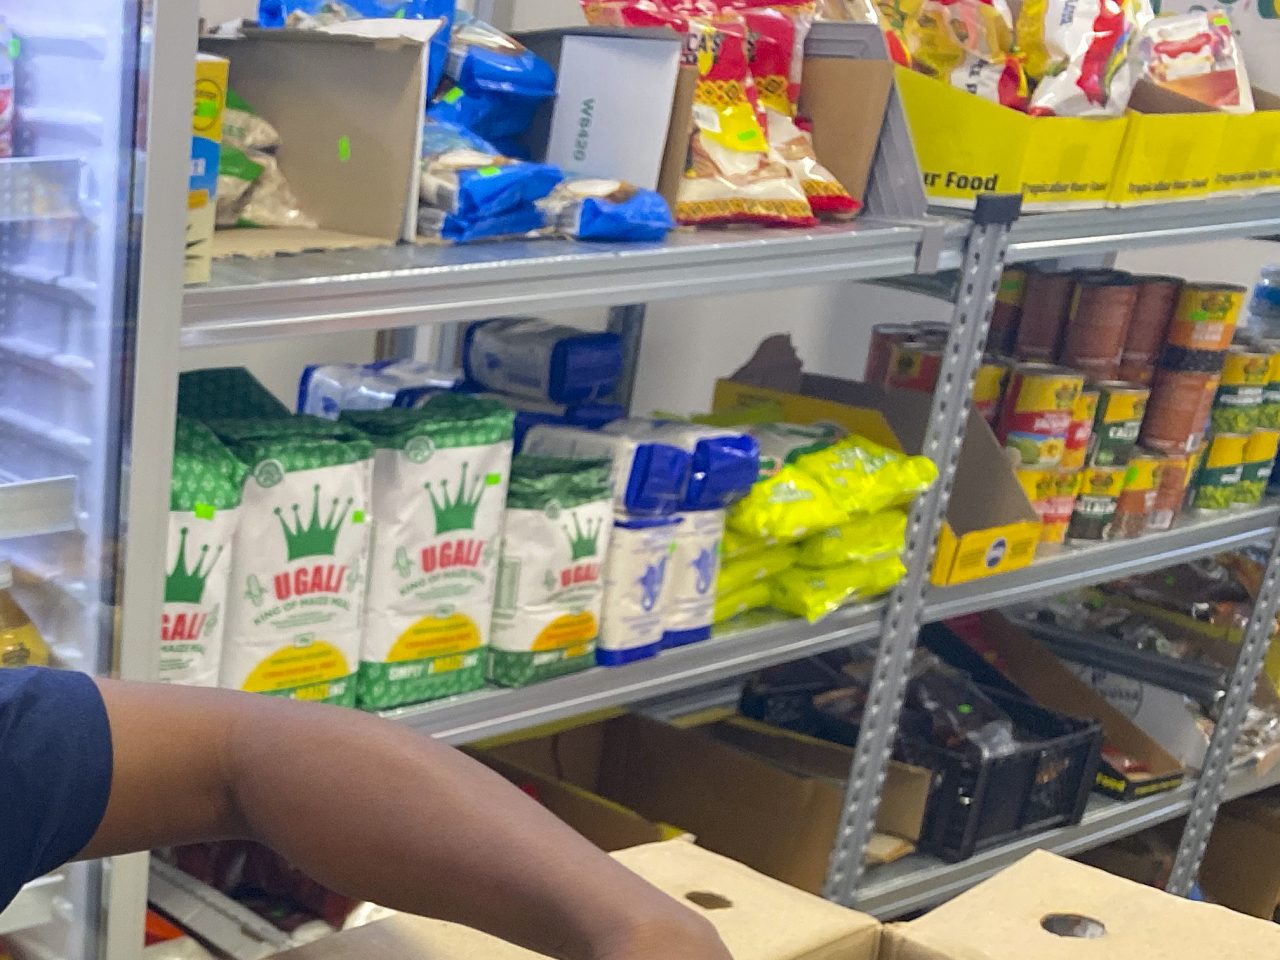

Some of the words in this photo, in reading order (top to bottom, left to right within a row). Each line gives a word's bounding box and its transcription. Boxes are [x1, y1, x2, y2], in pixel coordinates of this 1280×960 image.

[945, 171, 999, 191] Food
[422, 539, 486, 573] UGALI
[274, 564, 347, 601] UGALI
